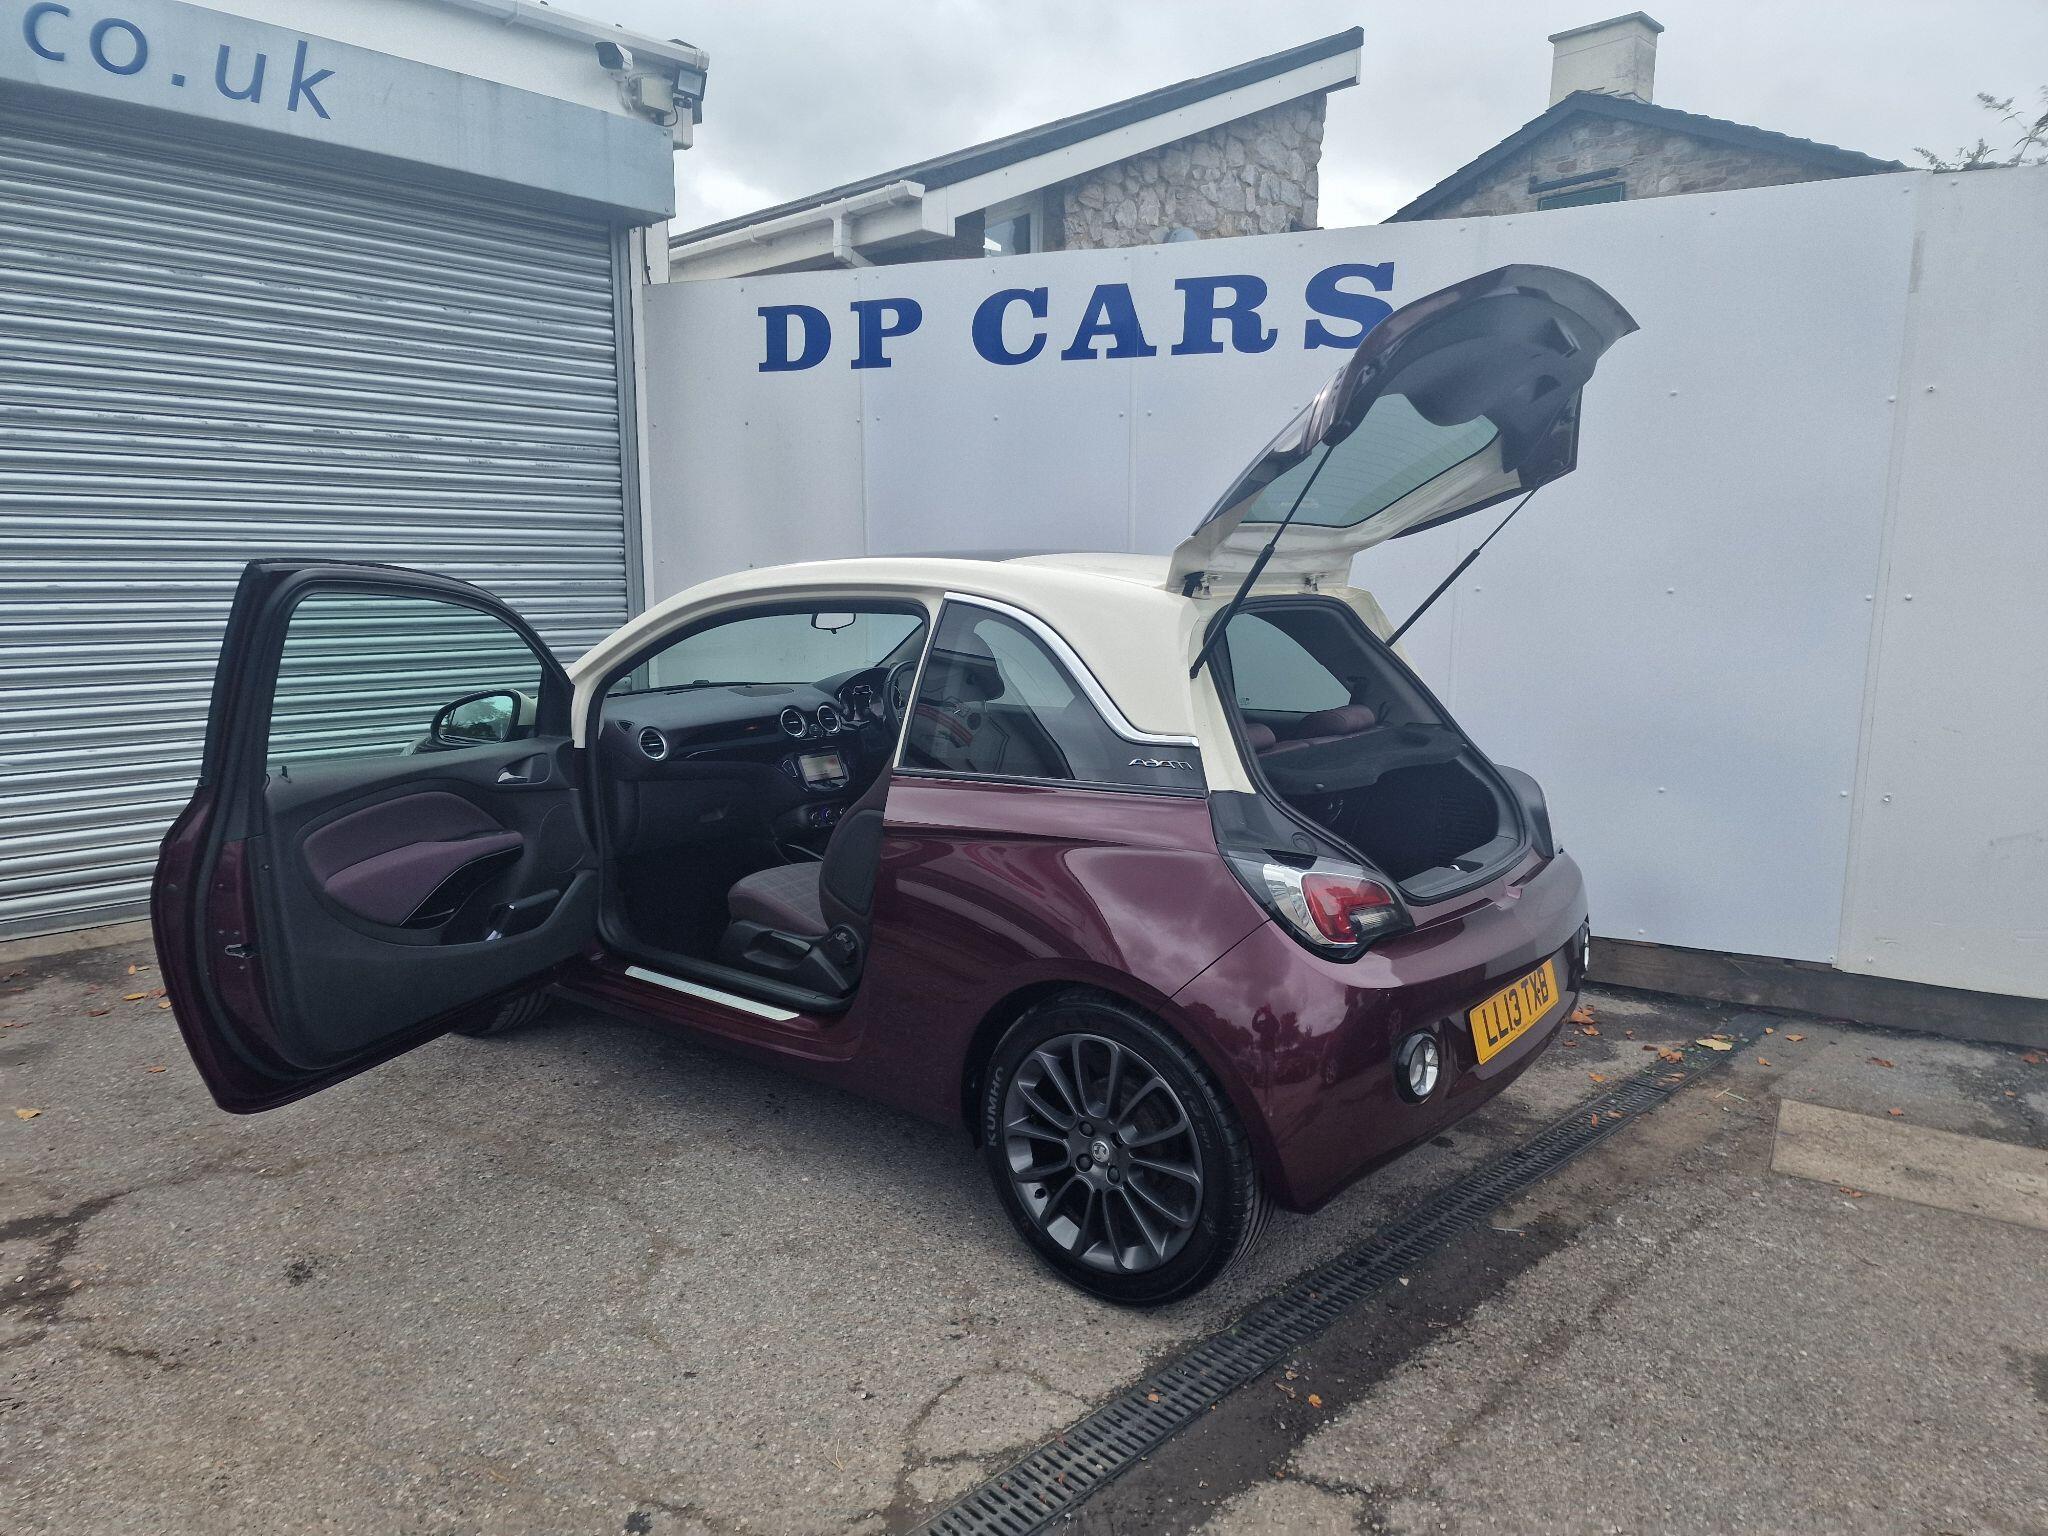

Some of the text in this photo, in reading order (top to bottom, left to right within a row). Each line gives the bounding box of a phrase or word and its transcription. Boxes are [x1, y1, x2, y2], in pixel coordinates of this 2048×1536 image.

[23, 2, 336, 120] co.uk
[758, 261, 1395, 372] DP CARS
[1482, 966, 1548, 1047] LL13 TXB
[986, 1066, 1004, 1147] KUMHO
